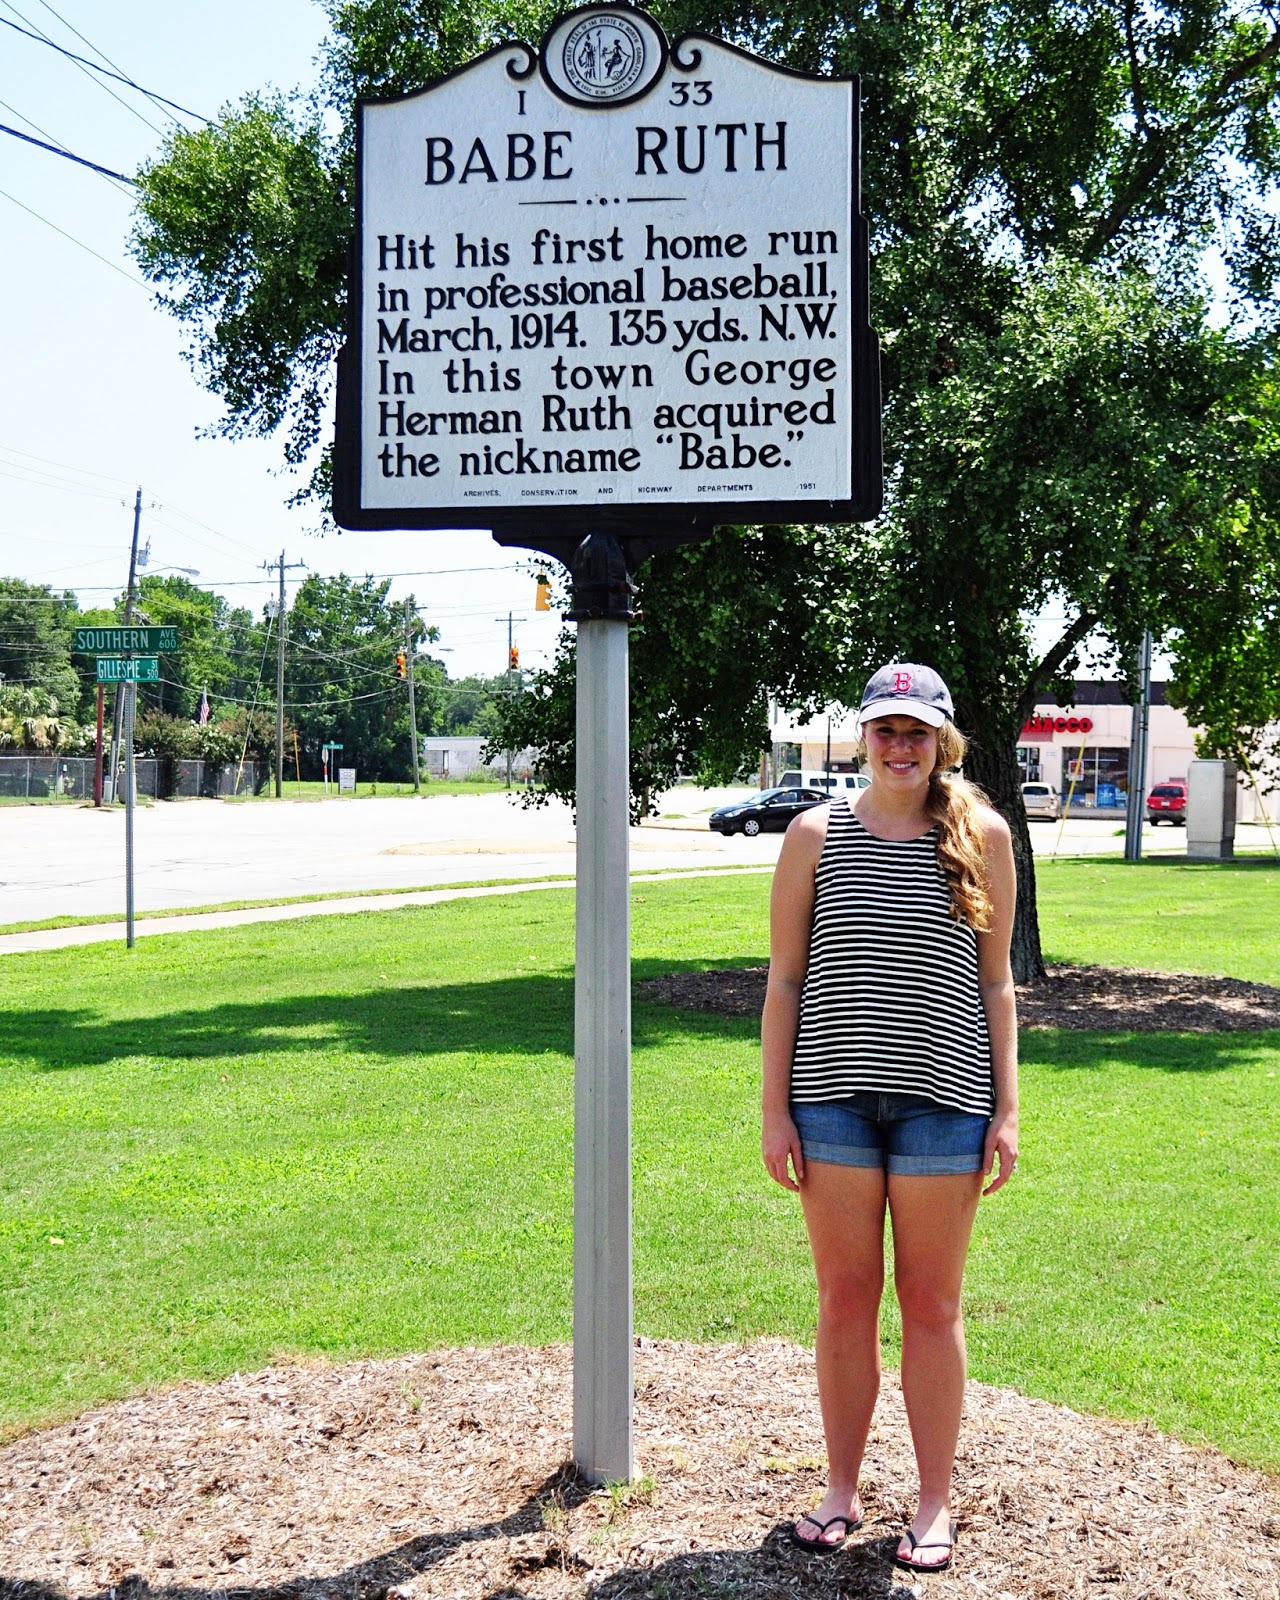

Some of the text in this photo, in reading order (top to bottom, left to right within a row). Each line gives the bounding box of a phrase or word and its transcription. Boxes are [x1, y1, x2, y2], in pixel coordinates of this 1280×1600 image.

[570, 31, 582, 43] SEAL
[668, 80, 713, 107] 33
[424, 121, 788, 186] BABE RUTH
[377, 224, 839, 272] Hit his first home run
[377, 260, 838, 320] in professional baseball,
[376, 302, 837, 355] March, 1914. 135 yds. N.W.
[378, 348, 837, 396] In this town George
[377, 388, 837, 440] Herman Ruth acquired
[377, 442, 440, 478] the
[459, 437, 642, 477] nickname
[520, 488, 579, 497] CONSERVATION
[597, 487, 614, 495] AND
[637, 486, 673, 494] HIGHWAY
[697, 484, 754, 493] DEPARTMENTS
[799, 482, 817, 491] 1951
[77, 629, 176, 650] SOUTHERN AVE
[158, 639, 177, 649] 600
[98, 660, 158, 679] GILLESPIE ST
[147, 669, 158, 679] 500
[891, 672, 913, 693] B
